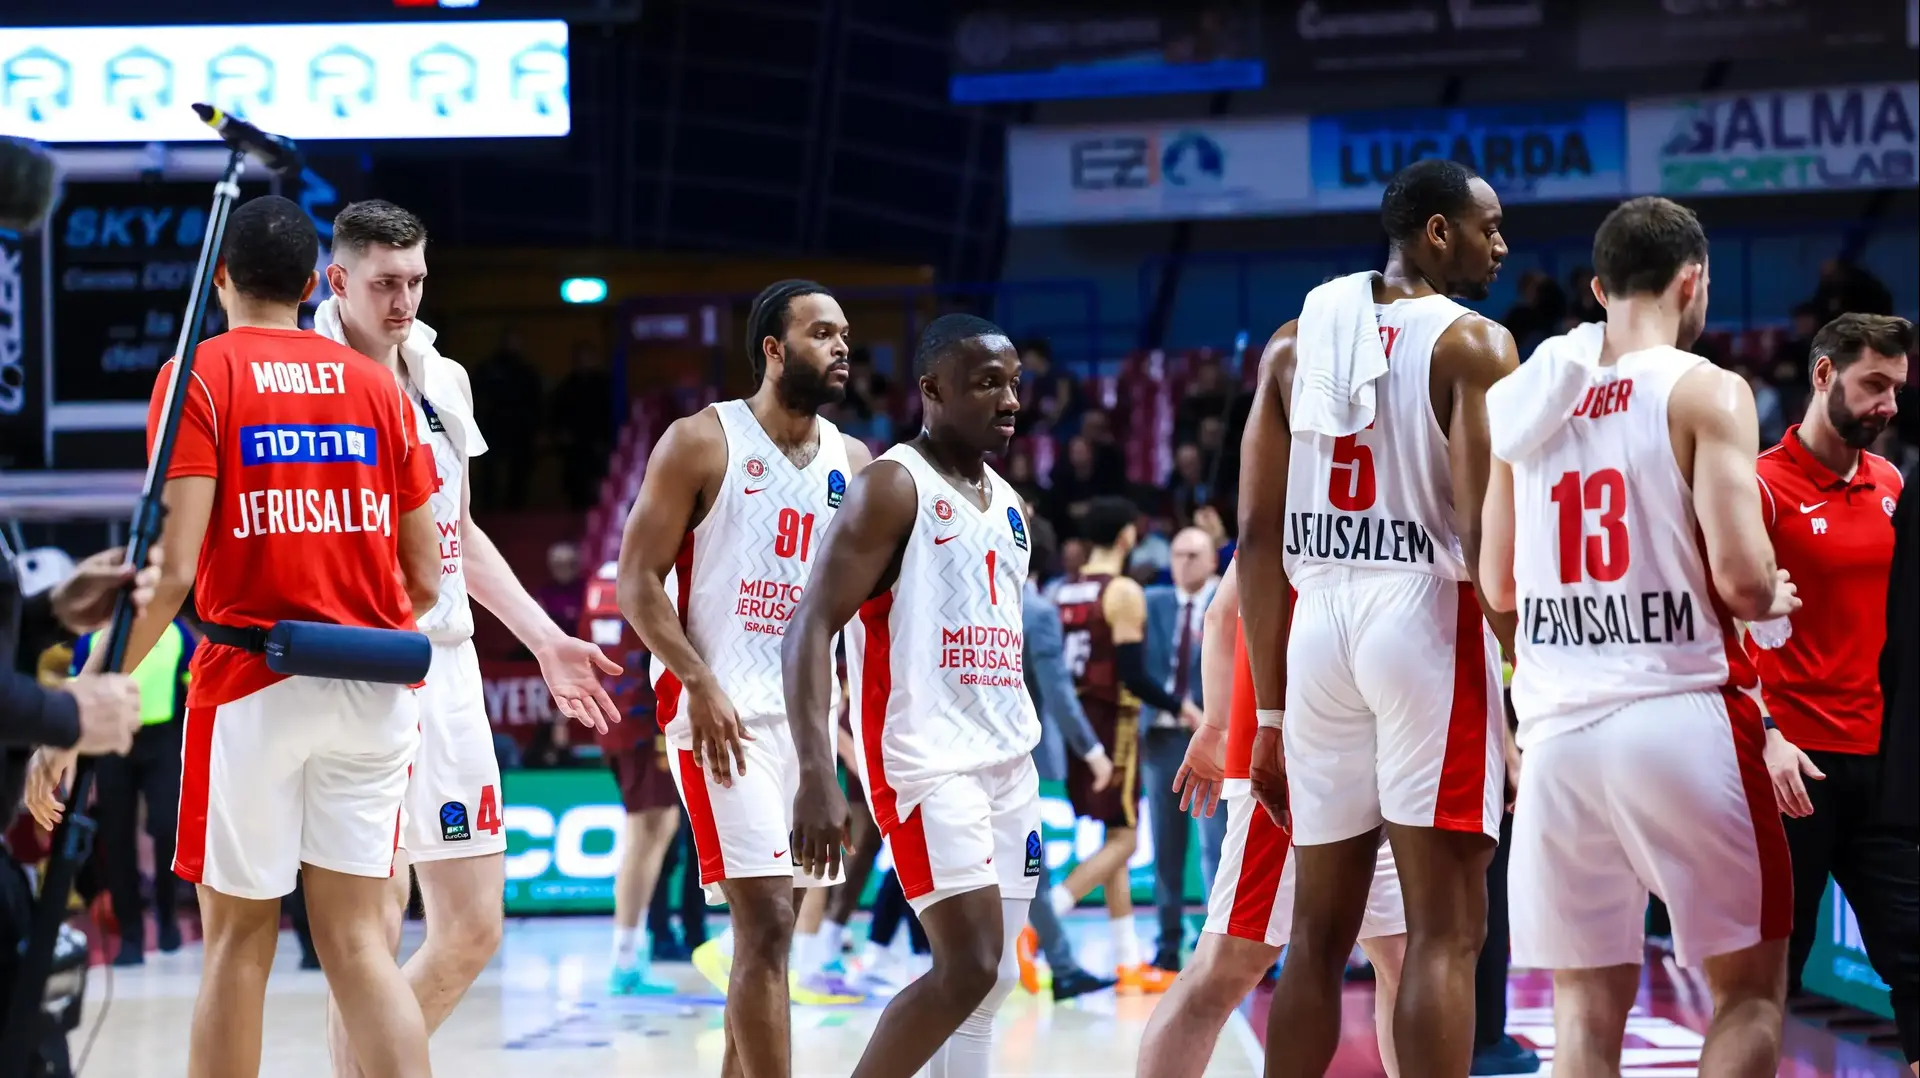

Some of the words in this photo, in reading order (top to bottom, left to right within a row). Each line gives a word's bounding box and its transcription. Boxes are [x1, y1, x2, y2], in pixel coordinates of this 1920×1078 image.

[64, 207, 172, 247] SKY
[251, 362, 346, 394] MOBLEY
[253, 428, 344, 458] הדסה
[1328, 420, 1377, 512] 5
[233, 488, 391, 539] JERUSALEM
[1551, 467, 1630, 585] 13
[1810, 517, 1828, 535] PP
[774, 507, 815, 563] 91
[740, 578, 805, 604] MIDTO
[985, 549, 998, 606] 1
[735, 597, 797, 622] JERUSA
[744, 621, 785, 636] ISRAELC
[942, 626, 1022, 650] MIDTOW
[484, 676, 551, 726] YER
[476, 784, 502, 836] 4
[444, 832, 469, 840] EuroCup
